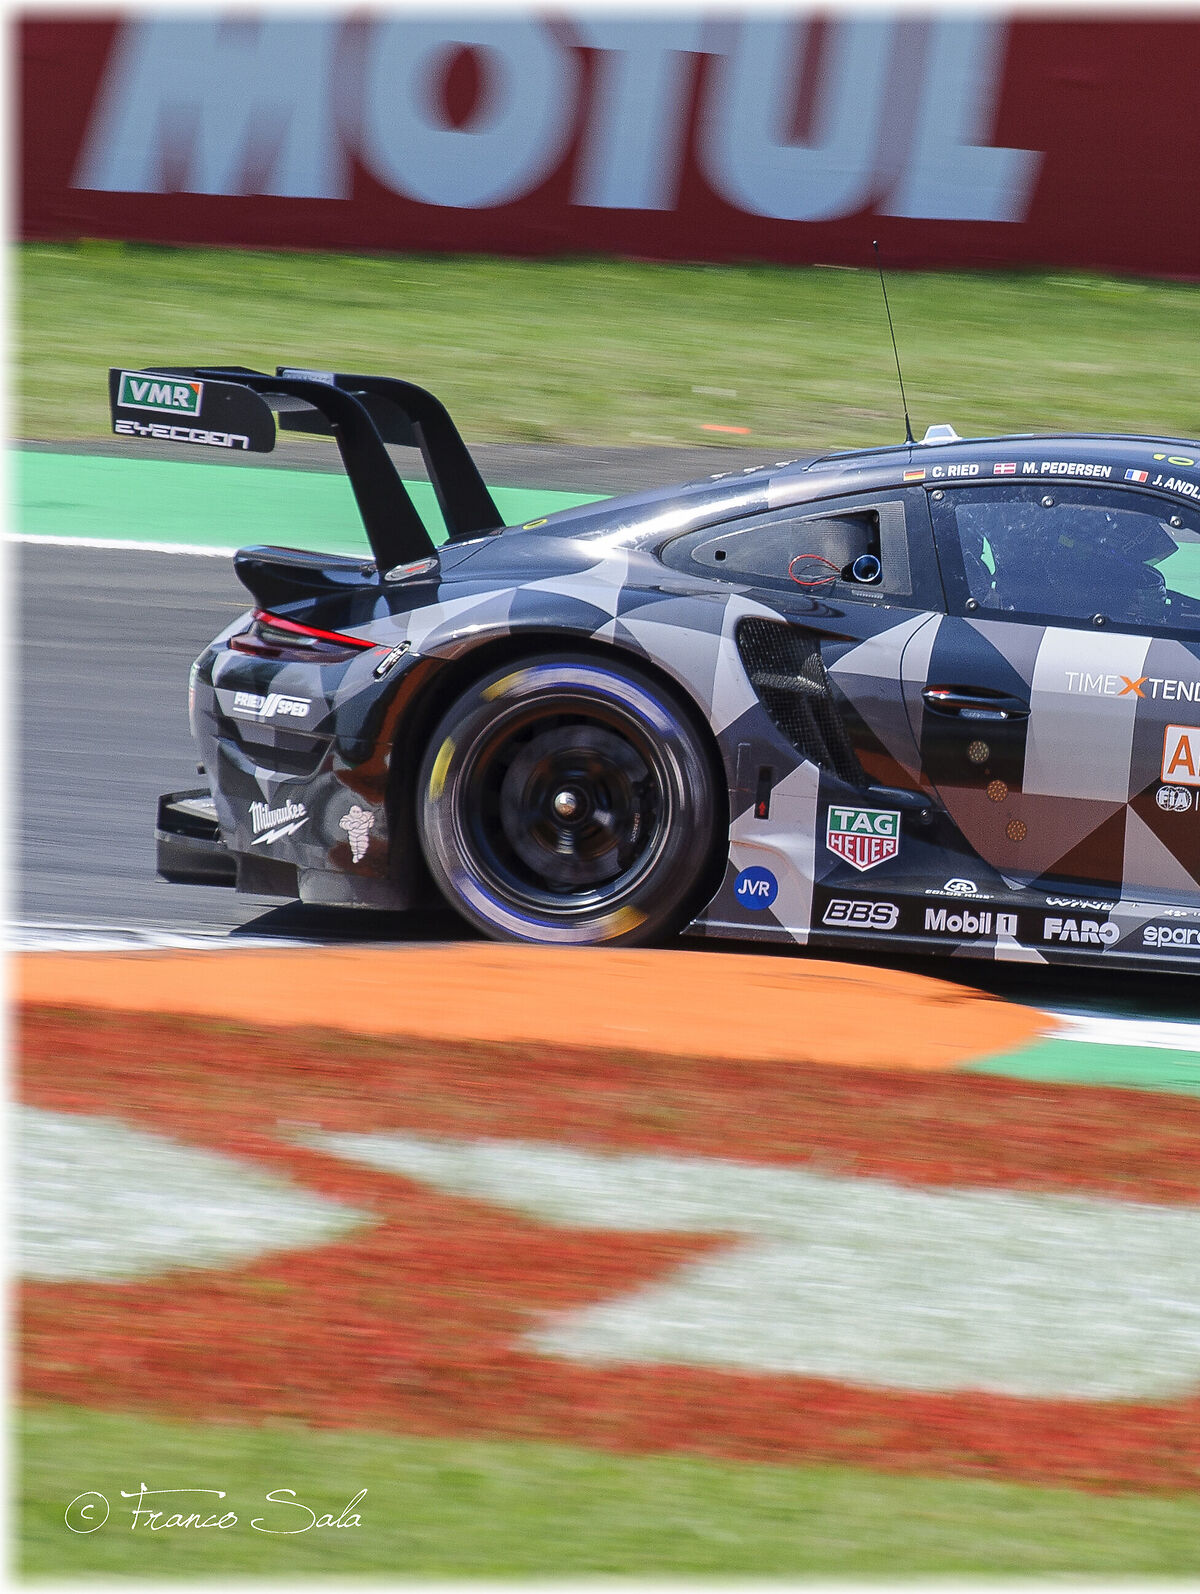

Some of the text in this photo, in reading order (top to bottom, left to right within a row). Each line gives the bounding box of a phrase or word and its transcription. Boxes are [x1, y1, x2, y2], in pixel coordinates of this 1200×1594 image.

[67, 10, 1044, 224] MOTUL
[129, 380, 190, 408] VMR
[931, 463, 979, 478] C. RIED
[1022, 462, 1112, 478] M. PEDERSEN
[1151, 472, 1164, 487] J.
[1157, 788, 1189, 810] FIA
[248, 799, 308, 834] Milwaukee
[834, 809, 894, 835] TAG
[829, 836, 895, 866] HEUER
[738, 879, 770, 898] JVR
[823, 899, 900, 931] BBS
[925, 908, 991, 935] Mobil
[1043, 917, 1121, 945] FARO
